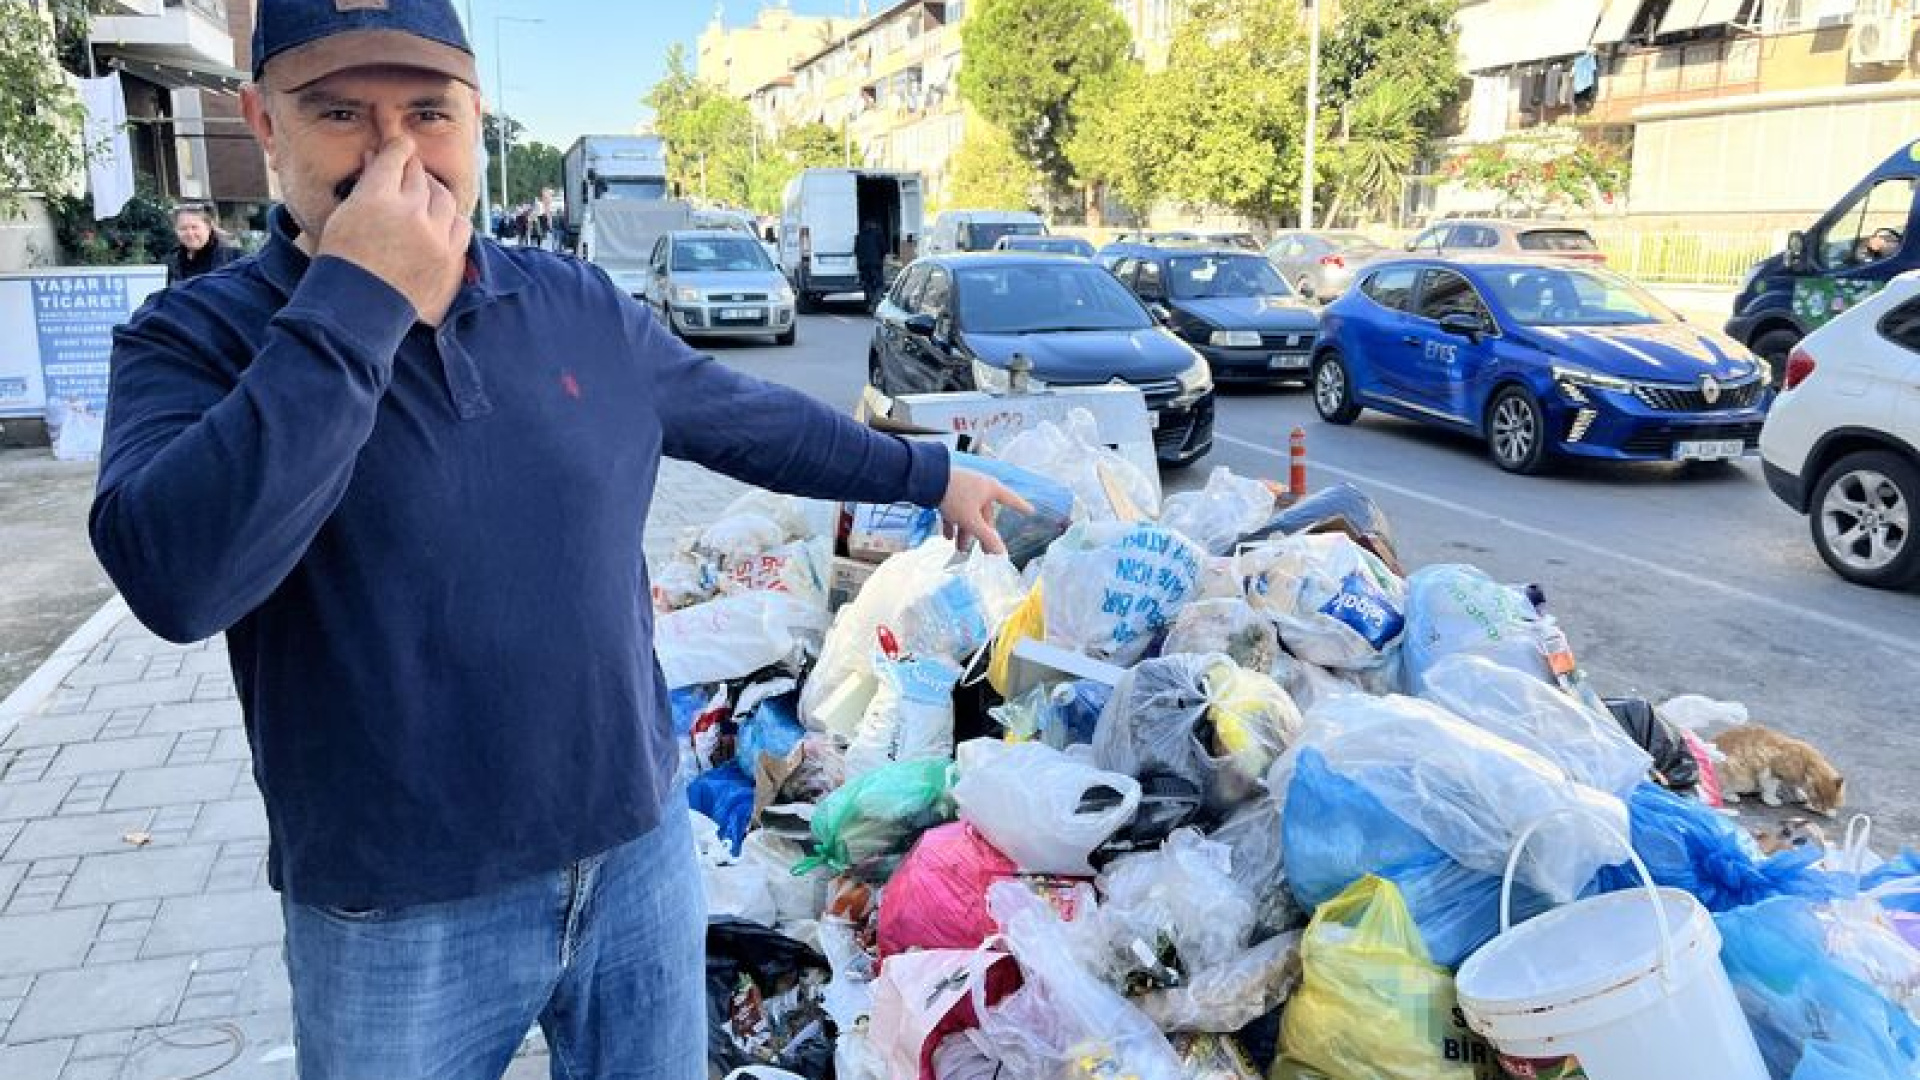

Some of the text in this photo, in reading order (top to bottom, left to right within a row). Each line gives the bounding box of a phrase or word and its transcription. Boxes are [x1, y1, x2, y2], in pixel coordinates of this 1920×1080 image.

[37, 277, 99, 293] YAŞAR
[40, 294, 122, 309] TİCARET
[1444, 1035, 1487, 1064] BİR
